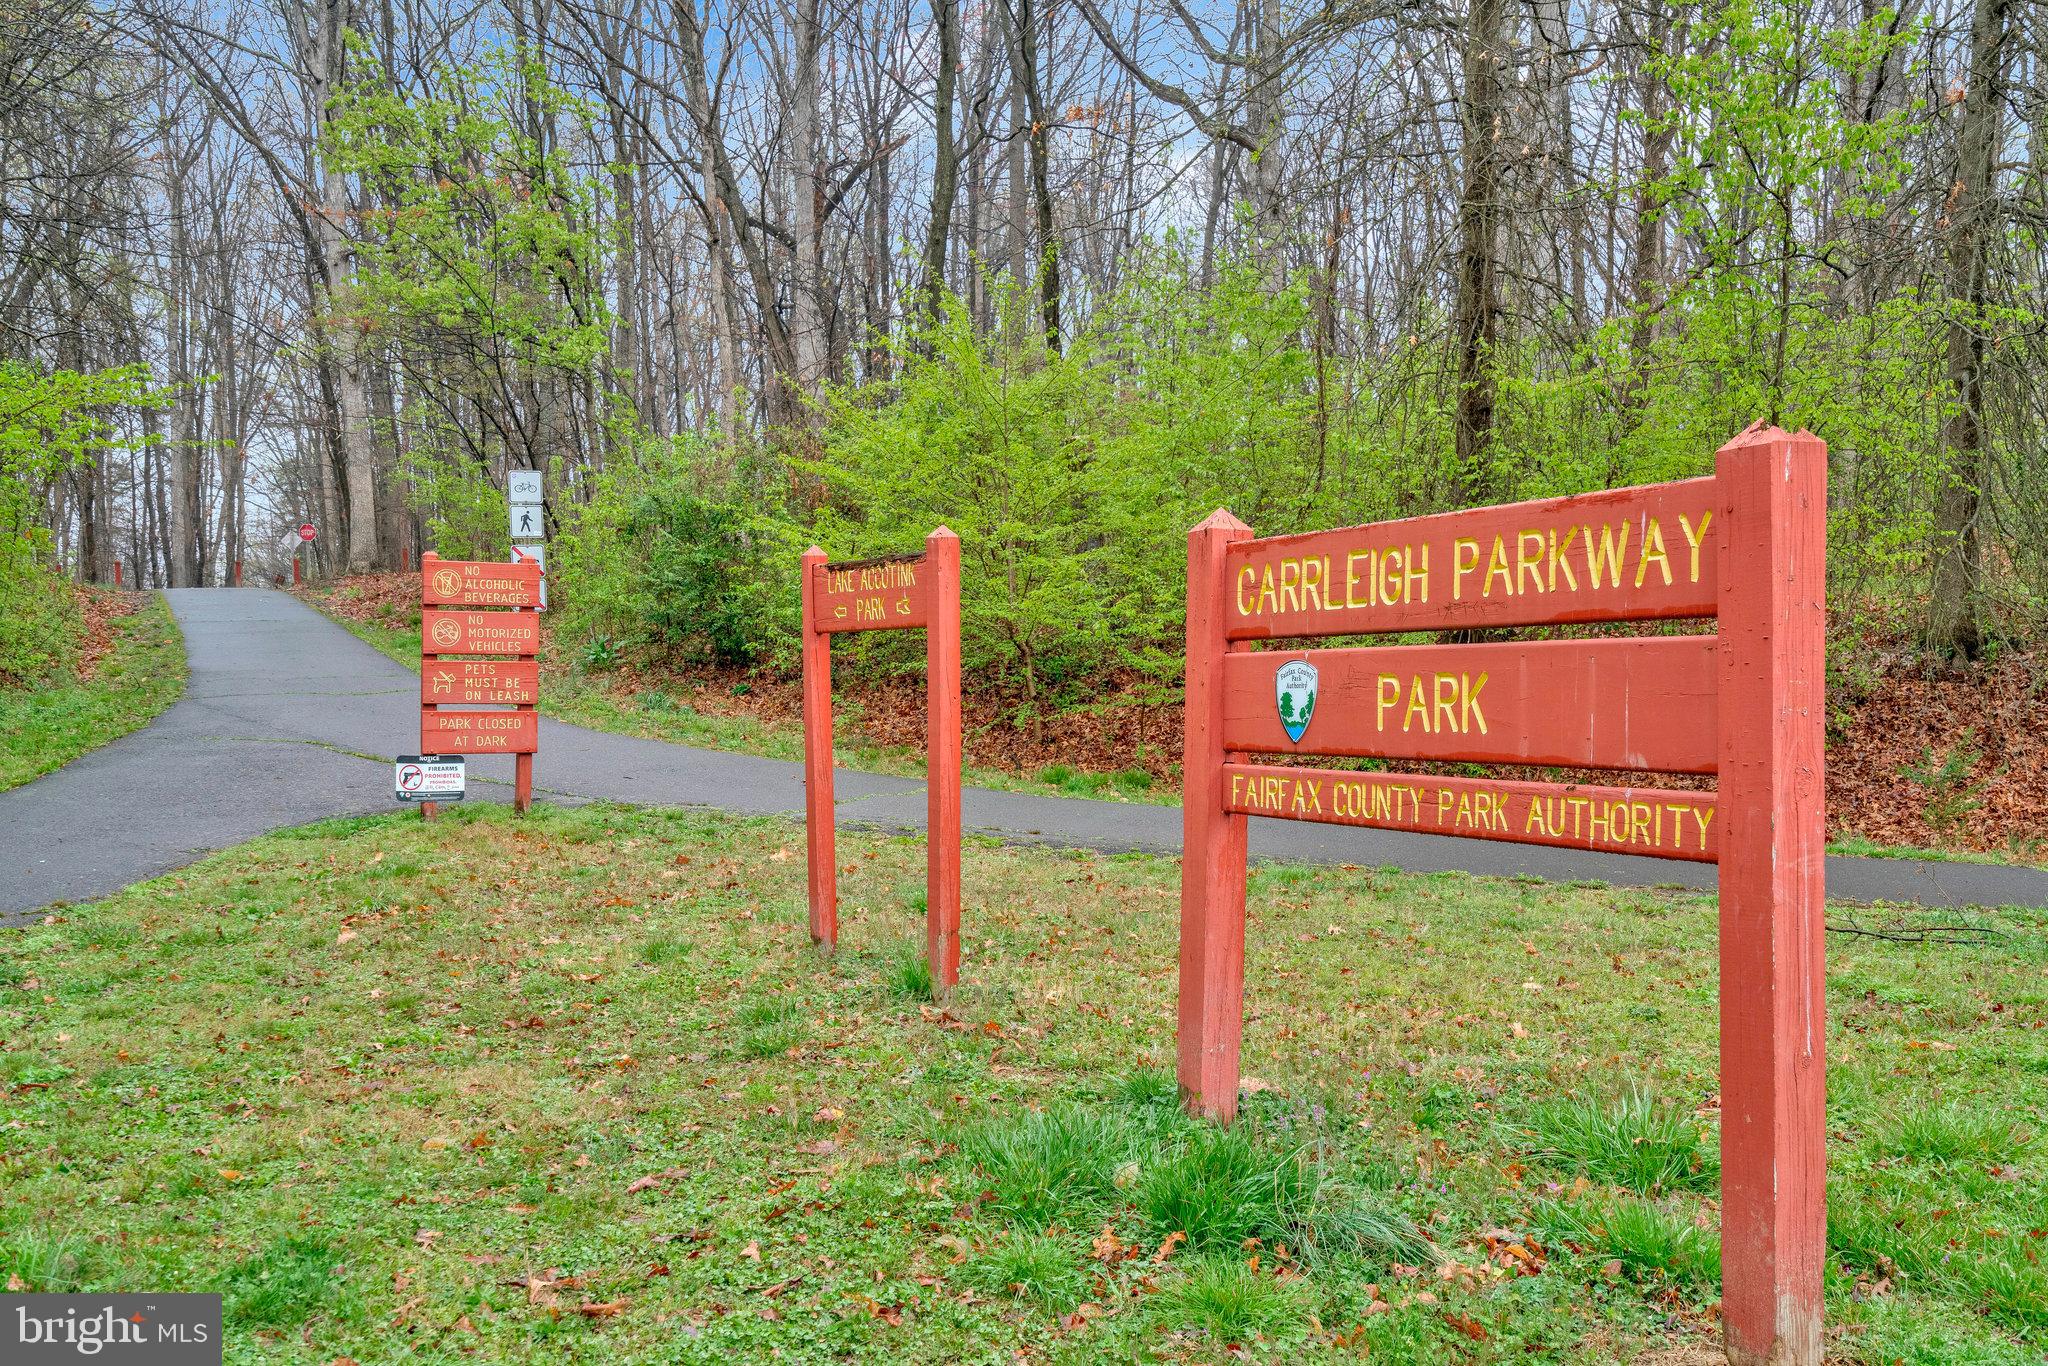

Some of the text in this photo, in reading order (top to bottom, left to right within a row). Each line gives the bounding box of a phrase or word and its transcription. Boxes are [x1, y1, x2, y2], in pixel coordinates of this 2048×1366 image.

[1236, 509, 1713, 617] CARRLEIGH PARKWAY
[464, 565, 480, 576] NO
[827, 561, 916, 594] LAKE ACCOTINK
[464, 579, 525, 591] ALCOHOLIC
[856, 597, 886, 622] PARK
[468, 615, 484, 625] NO
[468, 628, 531, 639] MOTORIZED
[469, 641, 521, 652] VEHICLES
[465, 664, 496, 675] PETS
[1297, 667, 1315, 682] County
[465, 677, 520, 689] MUST BE
[1286, 681, 1308, 690] Authority
[465, 690, 529, 701] ON LEASH
[1377, 671, 1489, 735] PARK
[440, 718, 522, 730] PARK CLOSED
[454, 735, 508, 747] AT DARK
[1232, 773, 1715, 850] FAIRFAX COUNTY PARK AUTHORITY
